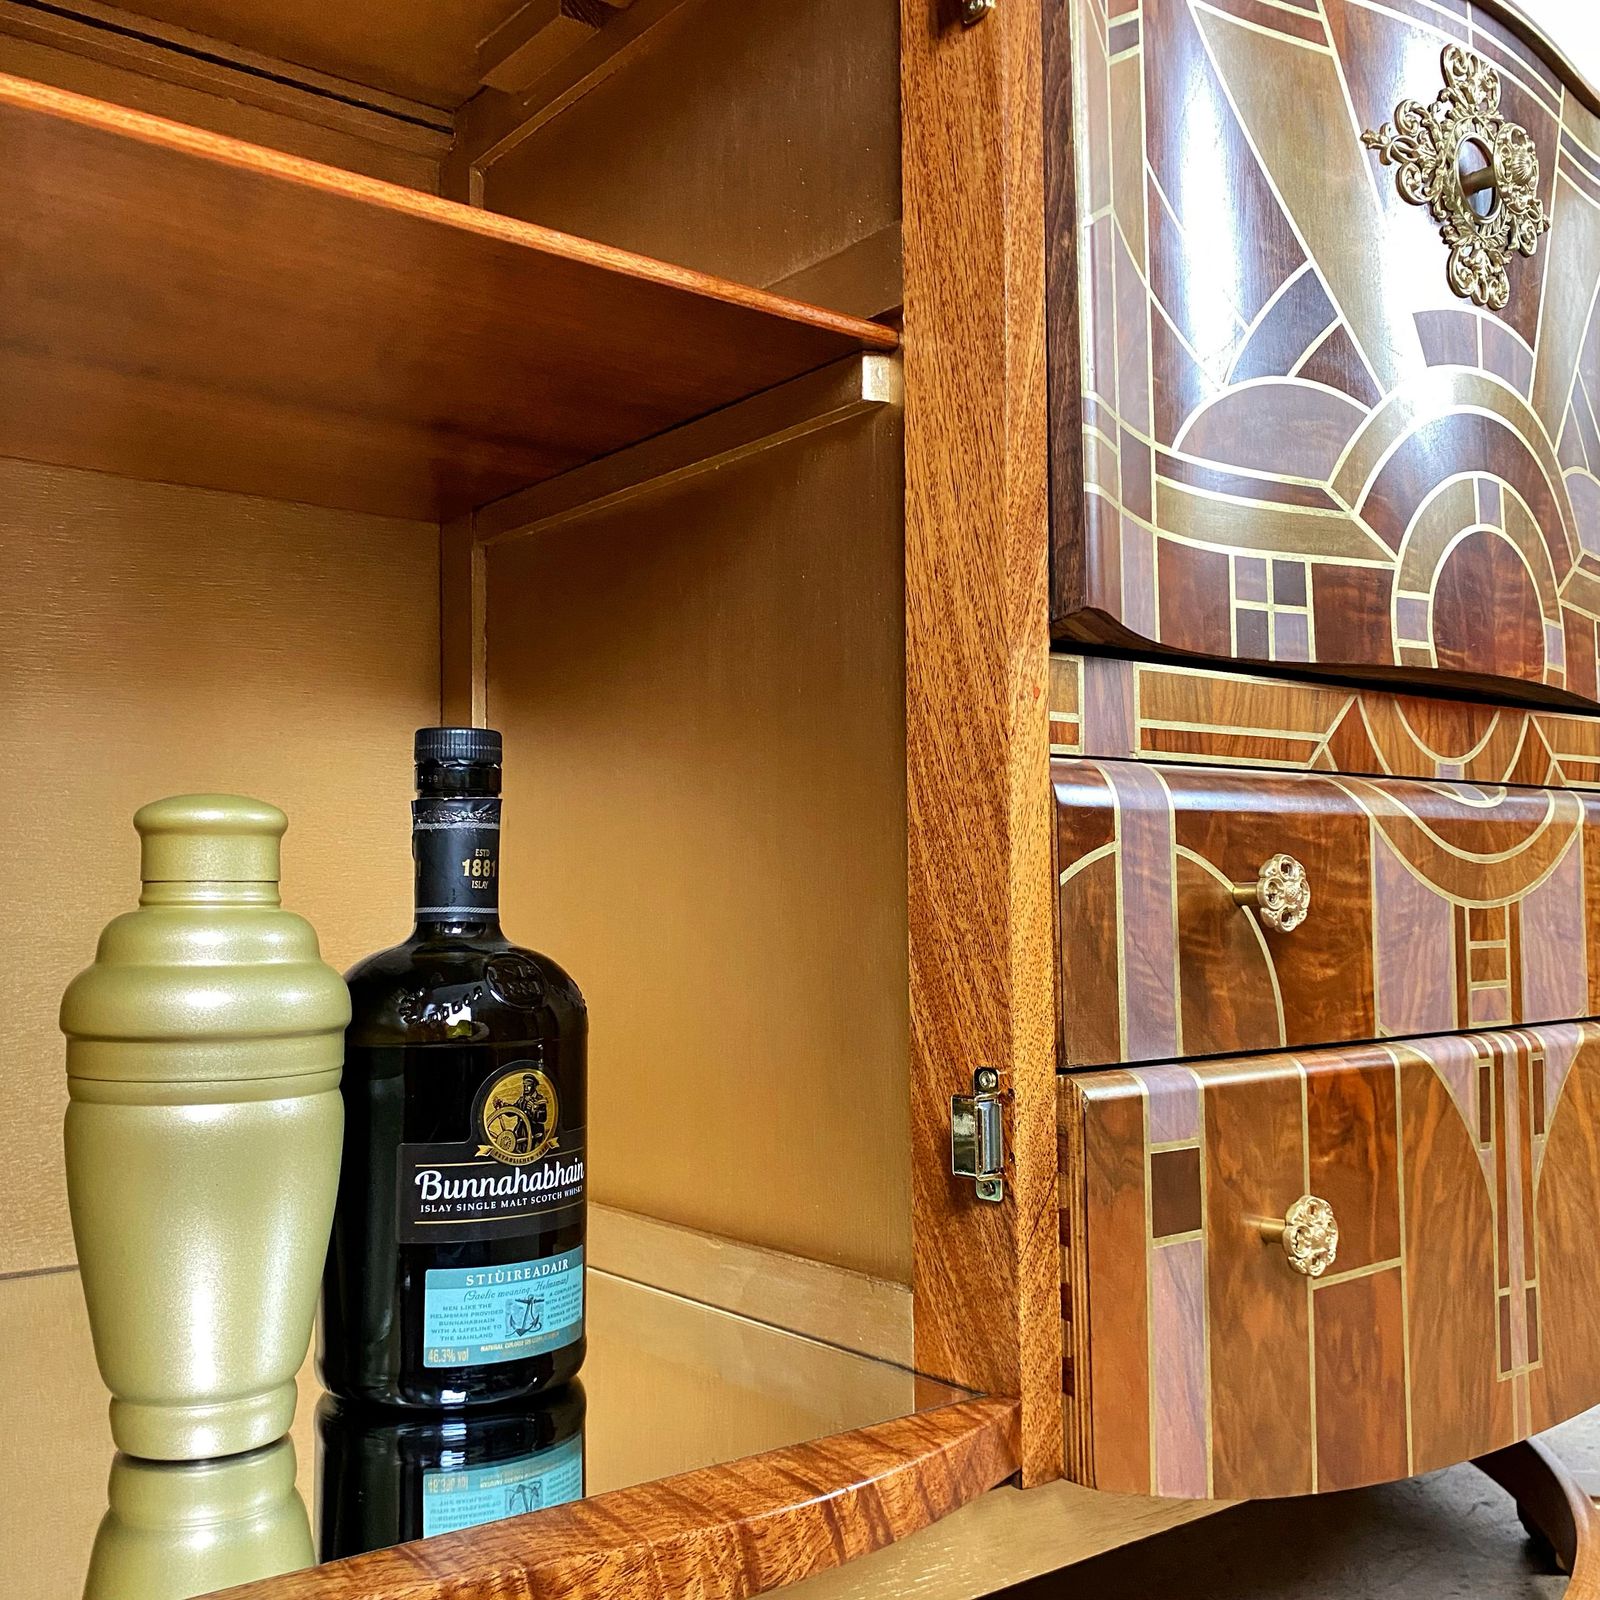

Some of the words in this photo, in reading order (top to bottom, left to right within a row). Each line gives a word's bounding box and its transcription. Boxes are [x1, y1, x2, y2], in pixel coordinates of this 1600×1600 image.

[475, 848, 490, 857] ESTD
[462, 859, 496, 877] 1881
[471, 880, 489, 889] ISLAY
[414, 1157, 585, 1201] Bunnahabhain
[420, 1204, 453, 1213] ISLAY
[456, 1201, 497, 1212] SINGLE
[500, 1197, 528, 1209] MALT
[530, 1191, 563, 1205] SCOTCH
[465, 1258, 569, 1287] STIÙIREADAIR
[470, 1309, 504, 1318] PROVIDED
[459, 1325, 492, 1333] LIFELINE
[456, 1332, 494, 1340] MAINLAND
[428, 1348, 456, 1363] 46.3%
[457, 1347, 469, 1361] vol
